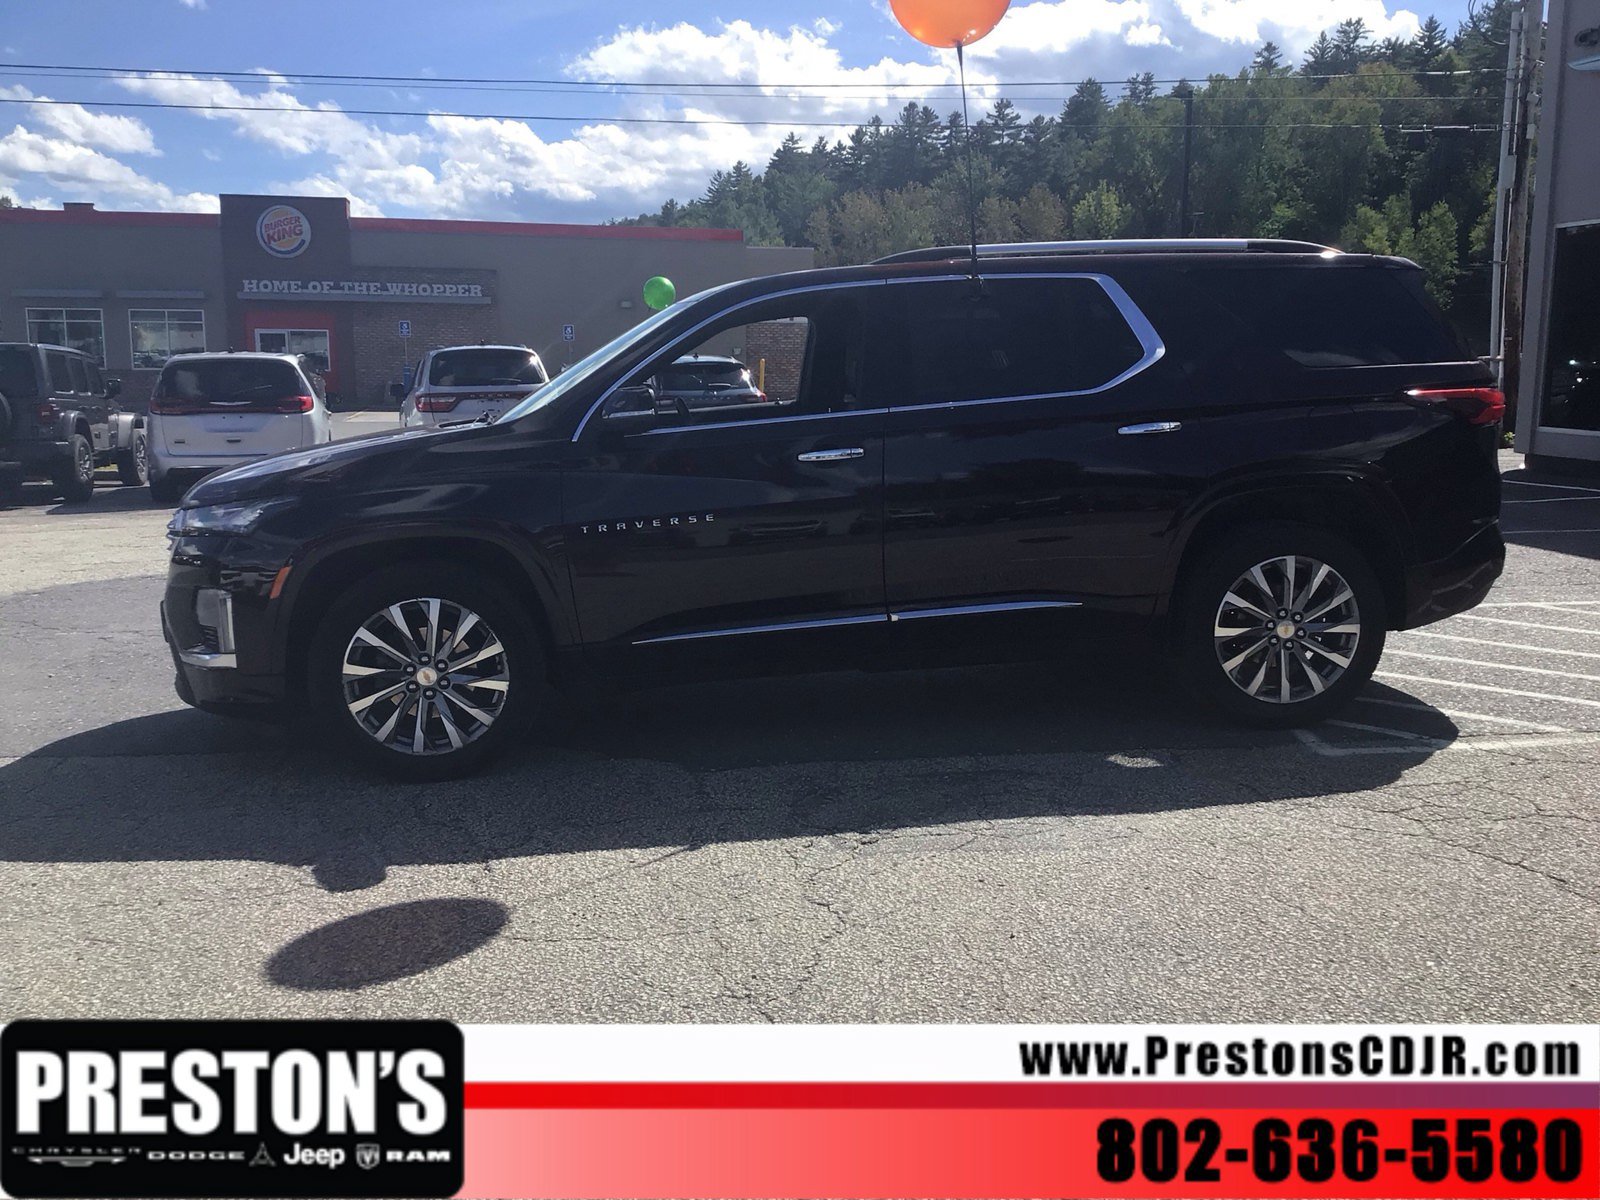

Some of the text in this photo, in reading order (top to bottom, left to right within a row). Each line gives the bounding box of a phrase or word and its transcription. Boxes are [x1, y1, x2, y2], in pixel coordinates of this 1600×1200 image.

[264, 216, 301, 233] BURGER
[267, 224, 303, 245] KING
[242, 279, 482, 297] HOME OF THE WHOPPER
[580, 513, 716, 534] TRAVERSE
